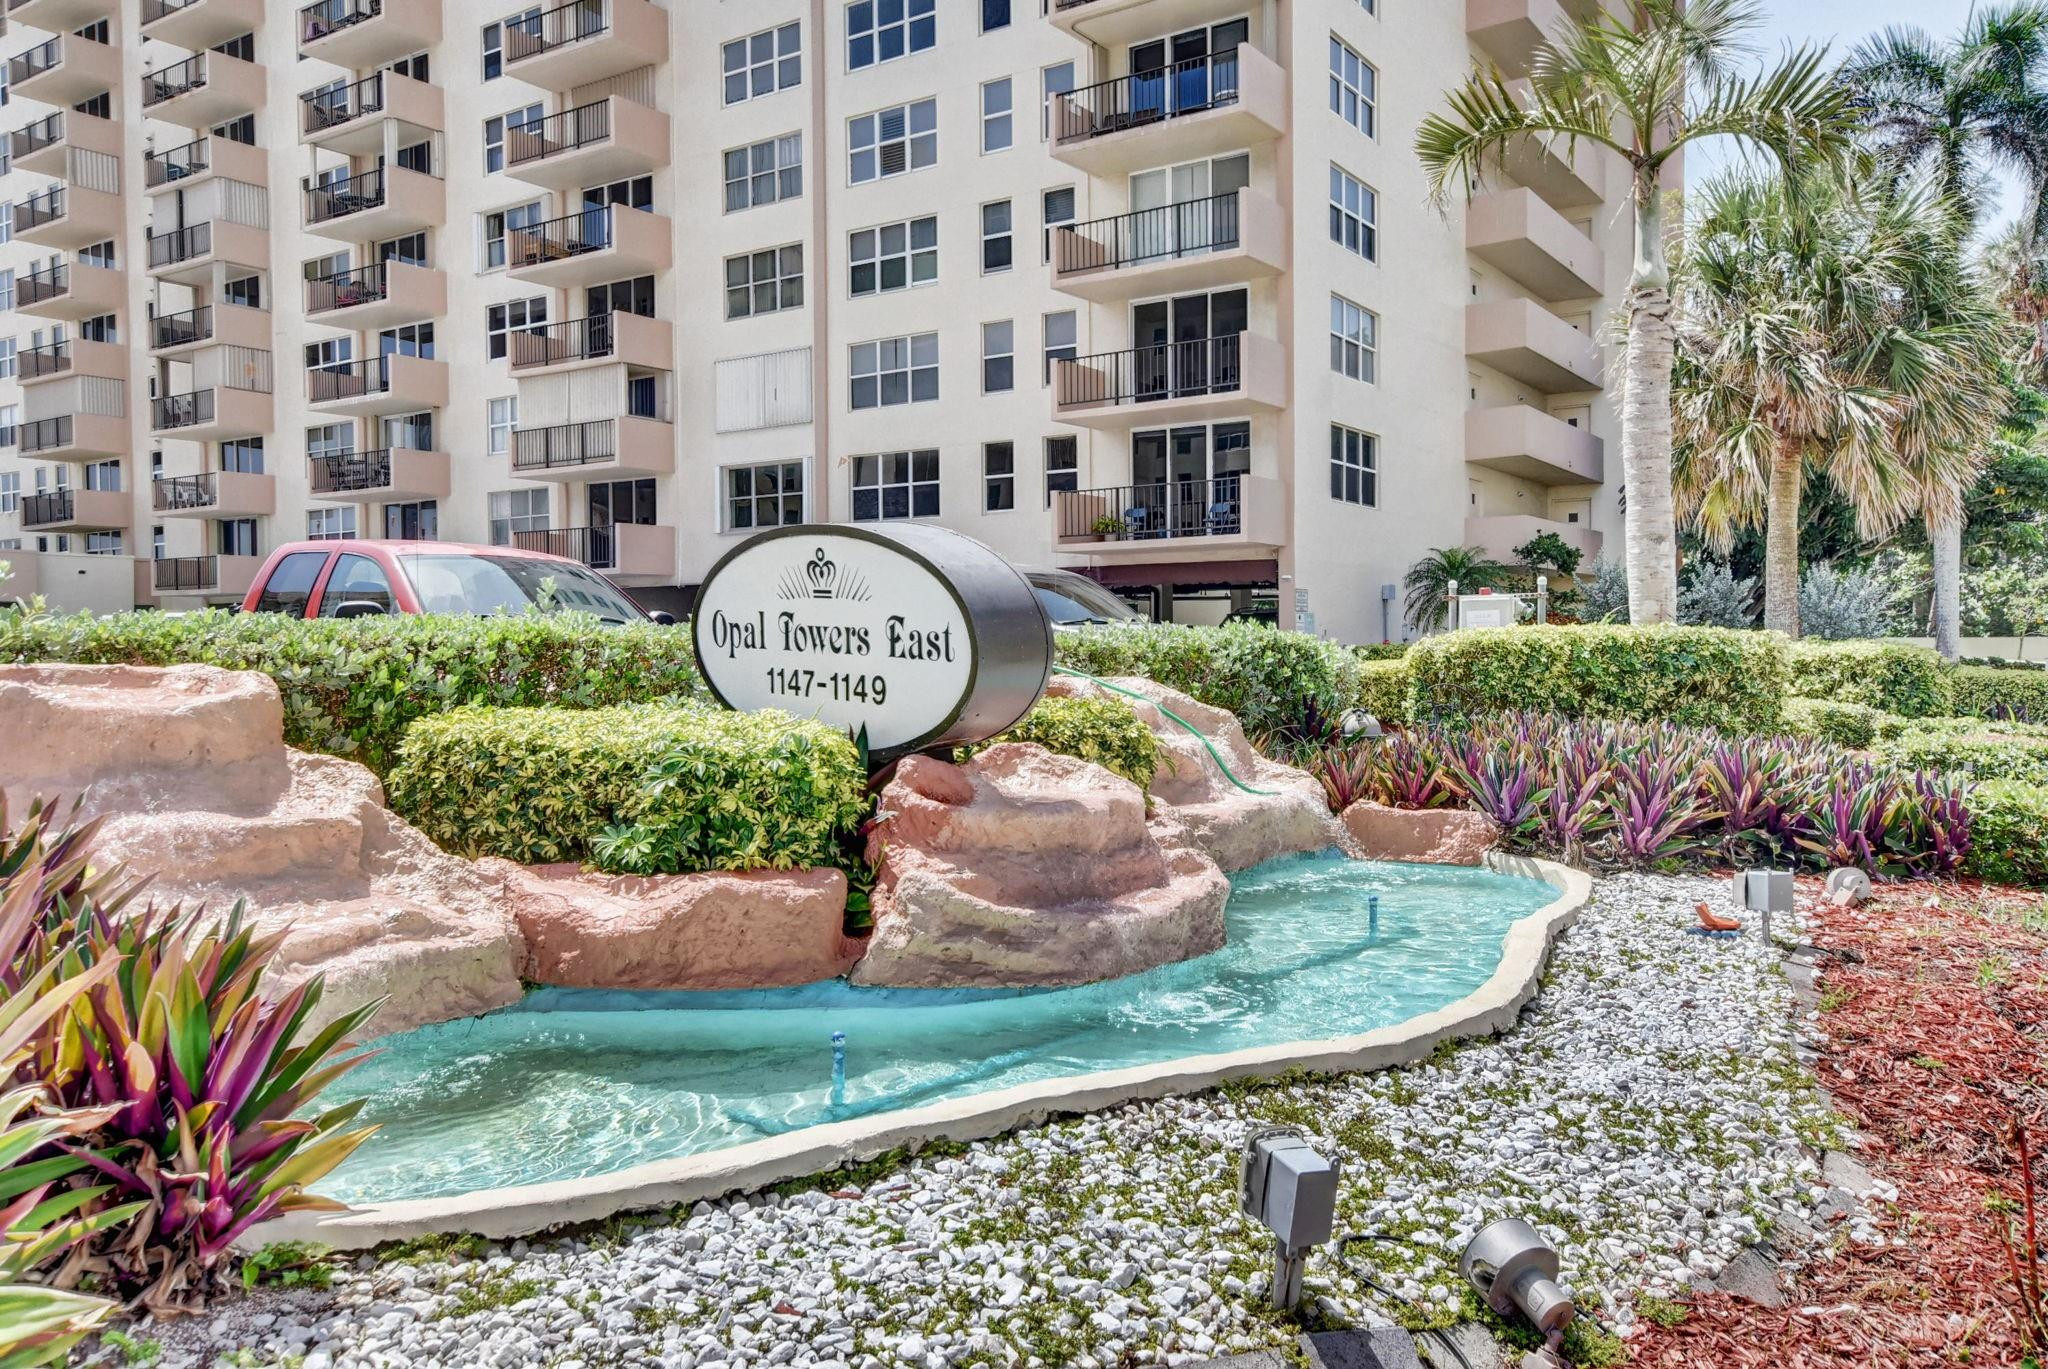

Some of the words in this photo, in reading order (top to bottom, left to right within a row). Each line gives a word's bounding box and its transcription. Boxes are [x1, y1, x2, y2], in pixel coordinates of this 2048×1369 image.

[712, 609, 767, 658] Opal
[777, 611, 870, 656] Towers
[885, 615, 955, 662] East
[766, 667, 886, 705] 1147-1149
